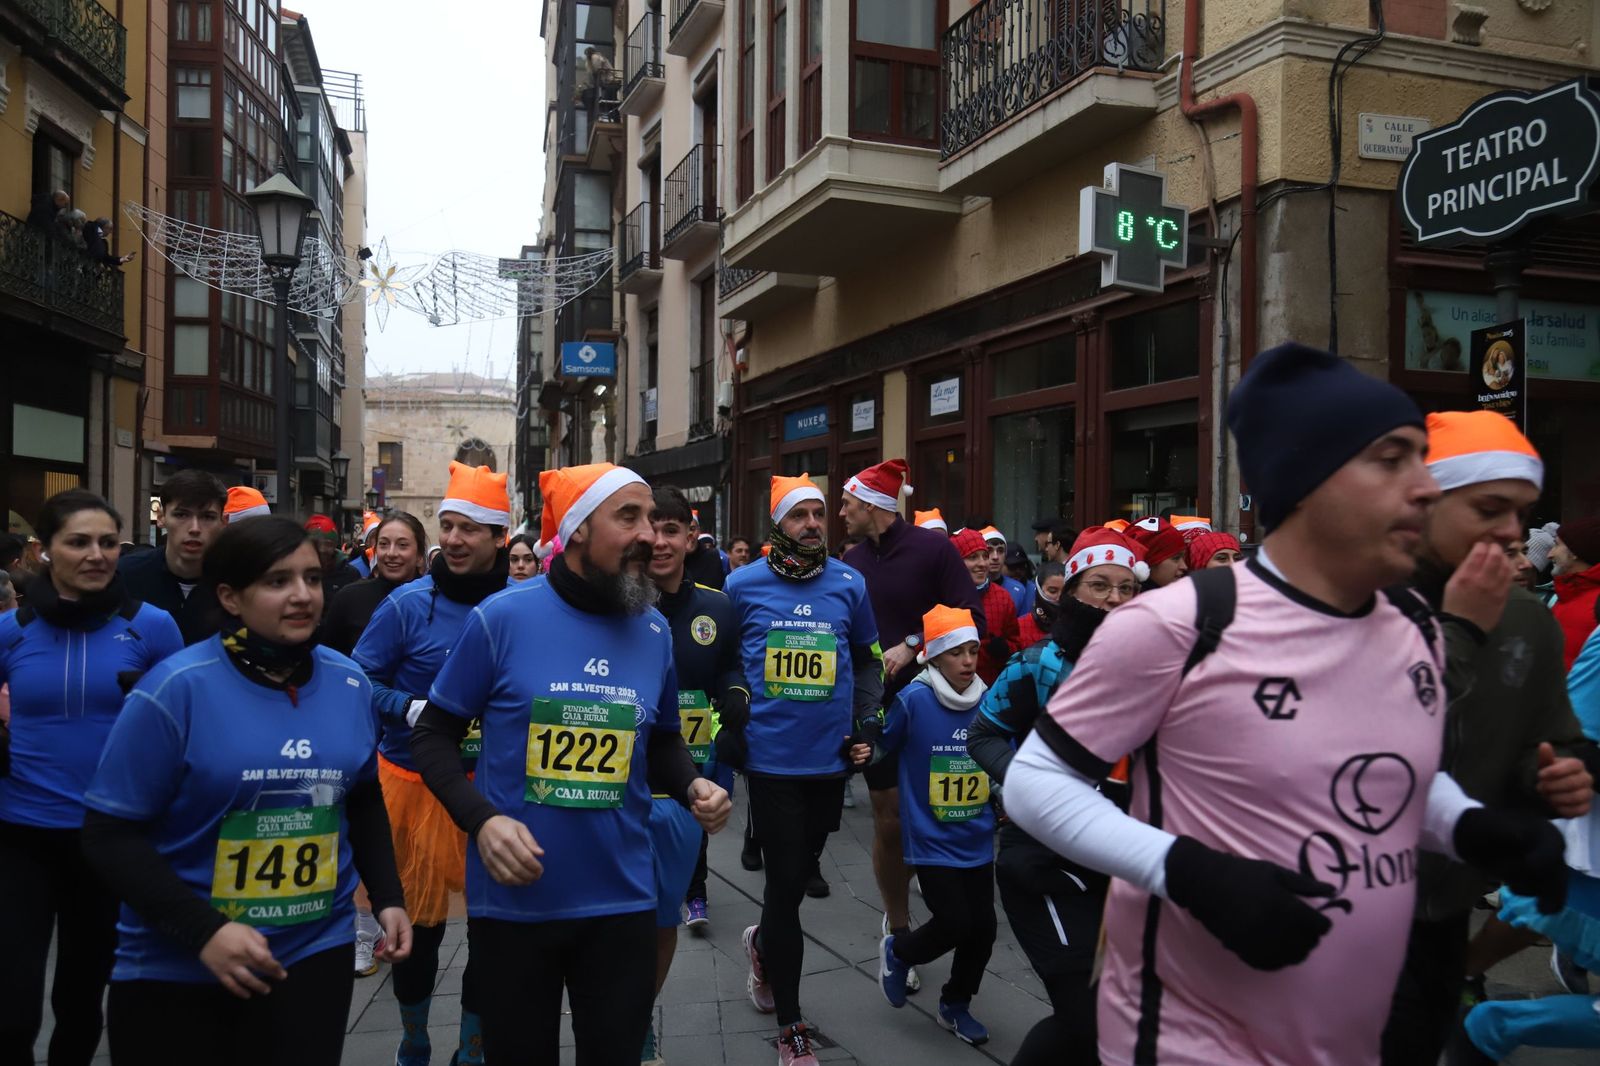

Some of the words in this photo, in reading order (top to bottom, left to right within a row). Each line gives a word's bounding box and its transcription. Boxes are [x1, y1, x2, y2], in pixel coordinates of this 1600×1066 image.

[1384, 121, 1414, 133] CALLE
[1389, 134, 1402, 144] DE
[1441, 118, 1547, 174] TEATRO
[1427, 157, 1568, 219] PRINCIPAL
[1117, 210, 1134, 242] 8
[1451, 307, 1469, 321] Un
[1547, 312, 1586, 330] salud
[1531, 333, 1543, 344] su
[1546, 331, 1586, 349] familia
[565, 364, 611, 374] Samsonite
[933, 385, 942, 397] La
[943, 384, 957, 395] mer
[797, 417, 819, 429] NUXE
[793, 604, 812, 616] 46
[784, 620, 816, 628] SILVESTRE
[583, 657, 609, 677] 46
[772, 650, 822, 679] 1106
[549, 682, 569, 692] SAN
[571, 682, 616, 696] SILVESTRE
[617, 686, 637, 698] 2025
[783, 687, 803, 696] CAJA
[804, 688, 829, 697] RURAL
[562, 711, 582, 722] CAJA
[583, 713, 609, 723] RURAL
[952, 728, 968, 741] 46
[280, 738, 312, 760] 46
[466, 743, 482, 752] CAJ
[536, 728, 619, 774] 1222
[690, 750, 706, 758] RAL
[242, 769, 265, 781] SAN
[266, 768, 319, 780] SILVESTRE
[320, 768, 343, 780] 2025
[555, 787, 584, 800] CAJA
[586, 789, 621, 801] RURAL
[938, 775, 979, 802] 112
[948, 809, 966, 818] CAJA
[256, 822, 281, 832] CAJA
[283, 819, 313, 831] RURAL
[227, 842, 320, 891] 148
[248, 905, 283, 919] CAJA
[286, 898, 327, 918] RURAL
